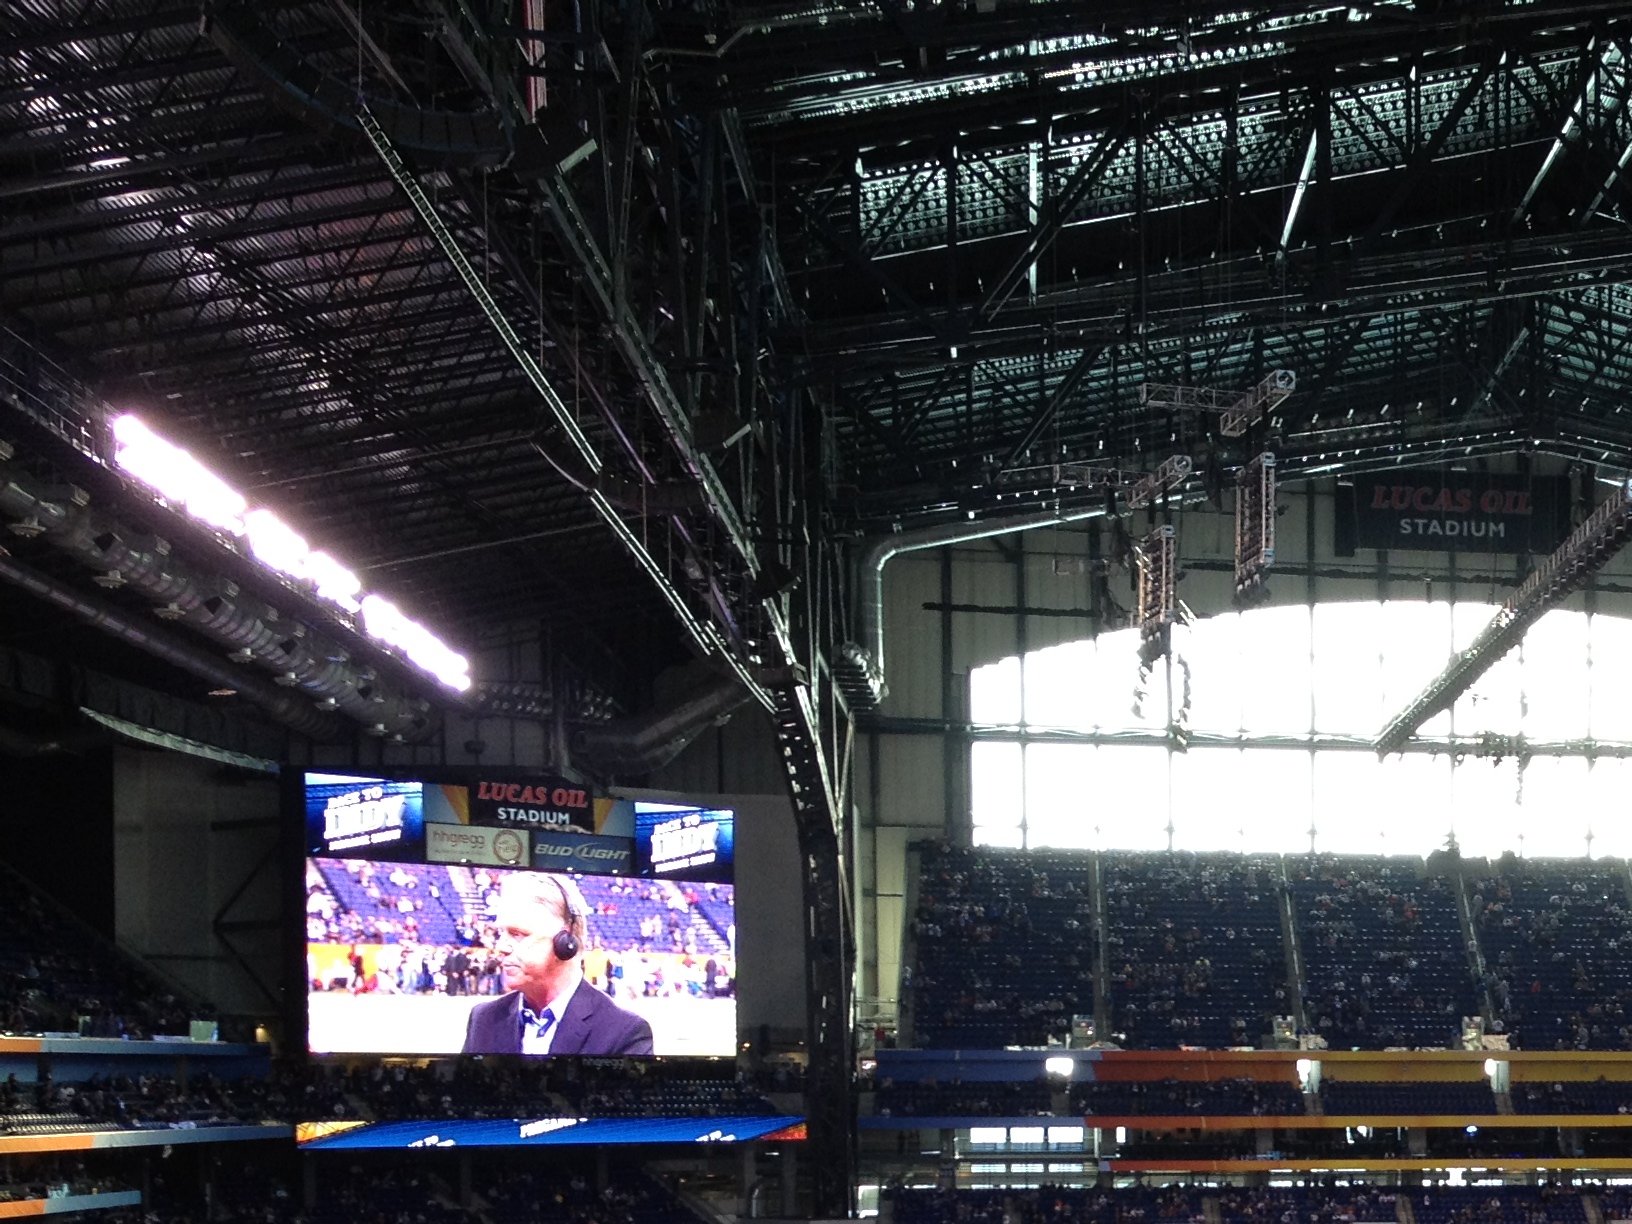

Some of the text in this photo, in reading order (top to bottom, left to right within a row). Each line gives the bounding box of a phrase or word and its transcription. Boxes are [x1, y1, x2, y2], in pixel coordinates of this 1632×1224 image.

[1371, 485, 1533, 514] LUCAS OIL
[1401, 518, 1505, 538] STADIUM
[478, 781, 588, 808] LUCAS OIL
[497, 807, 570, 825] STADIUM
[432, 830, 486, 849] hhgregg
[535, 843, 630, 861] BUD LIGHT
